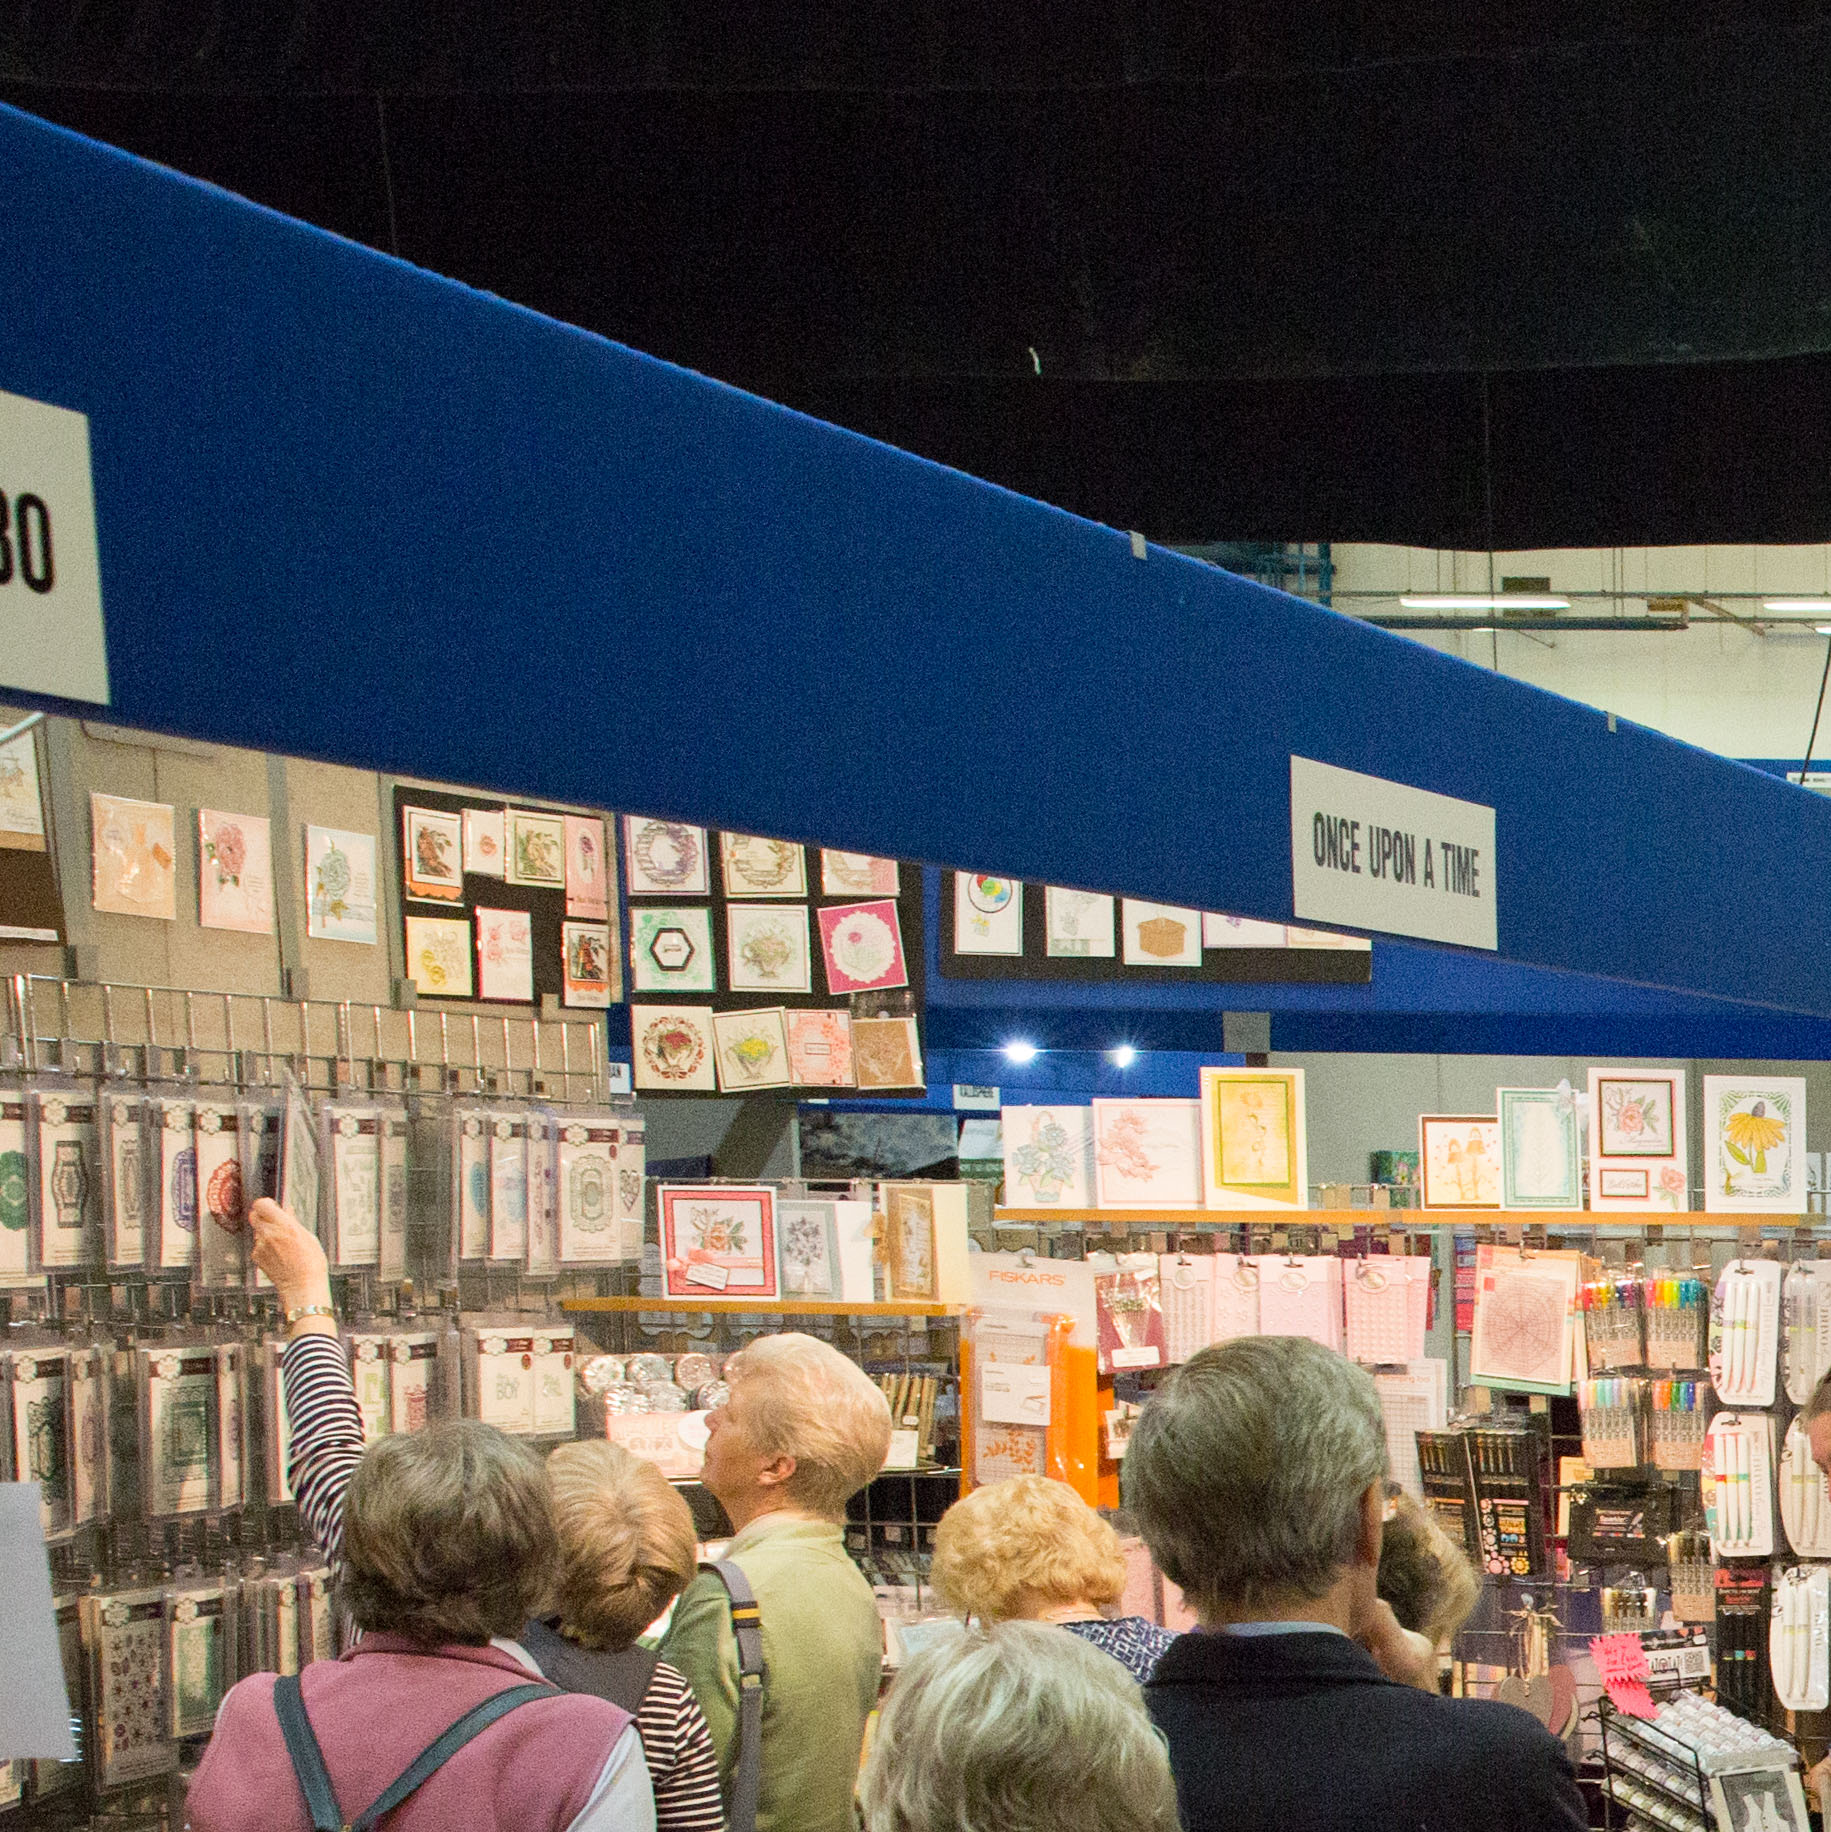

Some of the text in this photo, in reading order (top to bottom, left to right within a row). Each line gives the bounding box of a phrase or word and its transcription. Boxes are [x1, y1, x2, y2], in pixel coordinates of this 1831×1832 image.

[1313, 812, 1480, 897] ONCE UPON A TIME
[989, 1270, 1065, 1286] FISKARS
